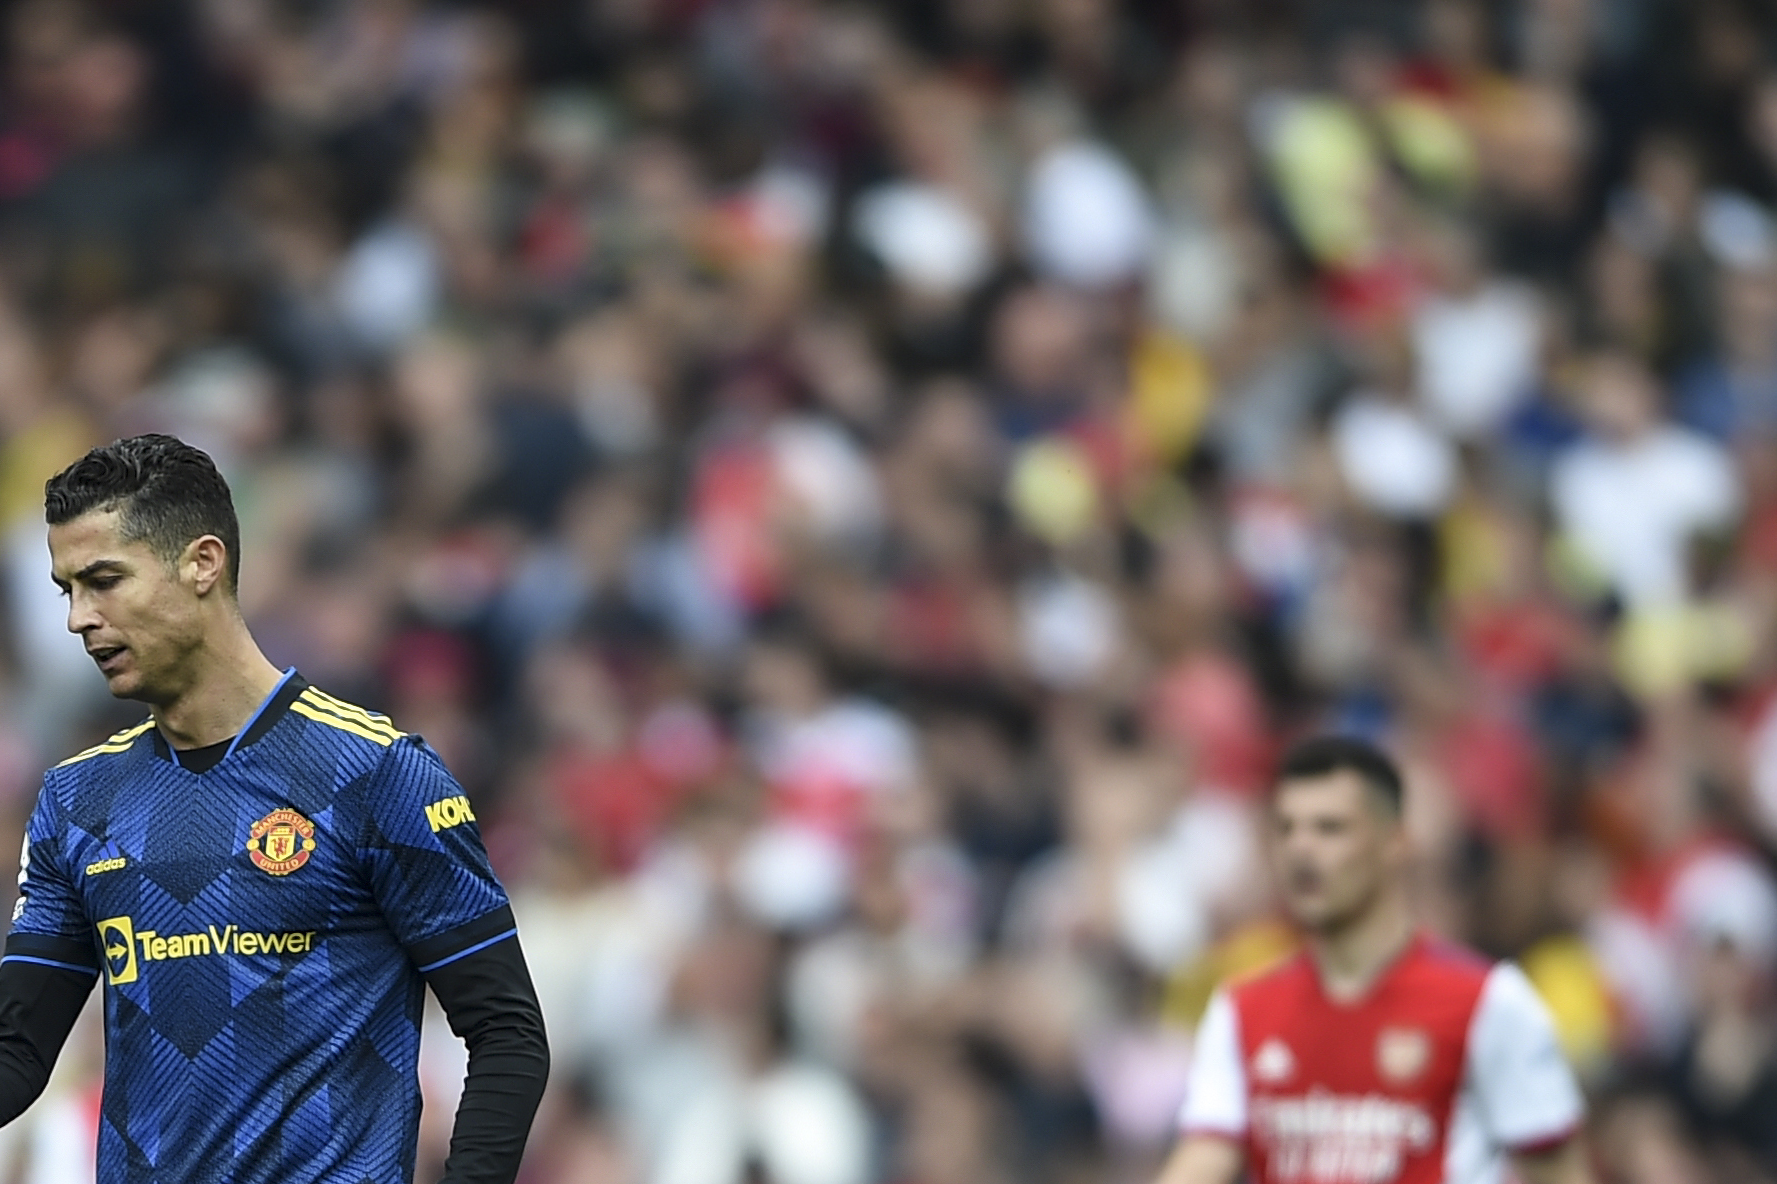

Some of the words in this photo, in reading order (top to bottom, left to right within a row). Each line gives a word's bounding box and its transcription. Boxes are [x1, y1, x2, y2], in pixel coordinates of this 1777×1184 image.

[424, 795, 477, 833] KOH
[85, 857, 126, 876] adidas
[135, 924, 317, 961] TeamViewer
